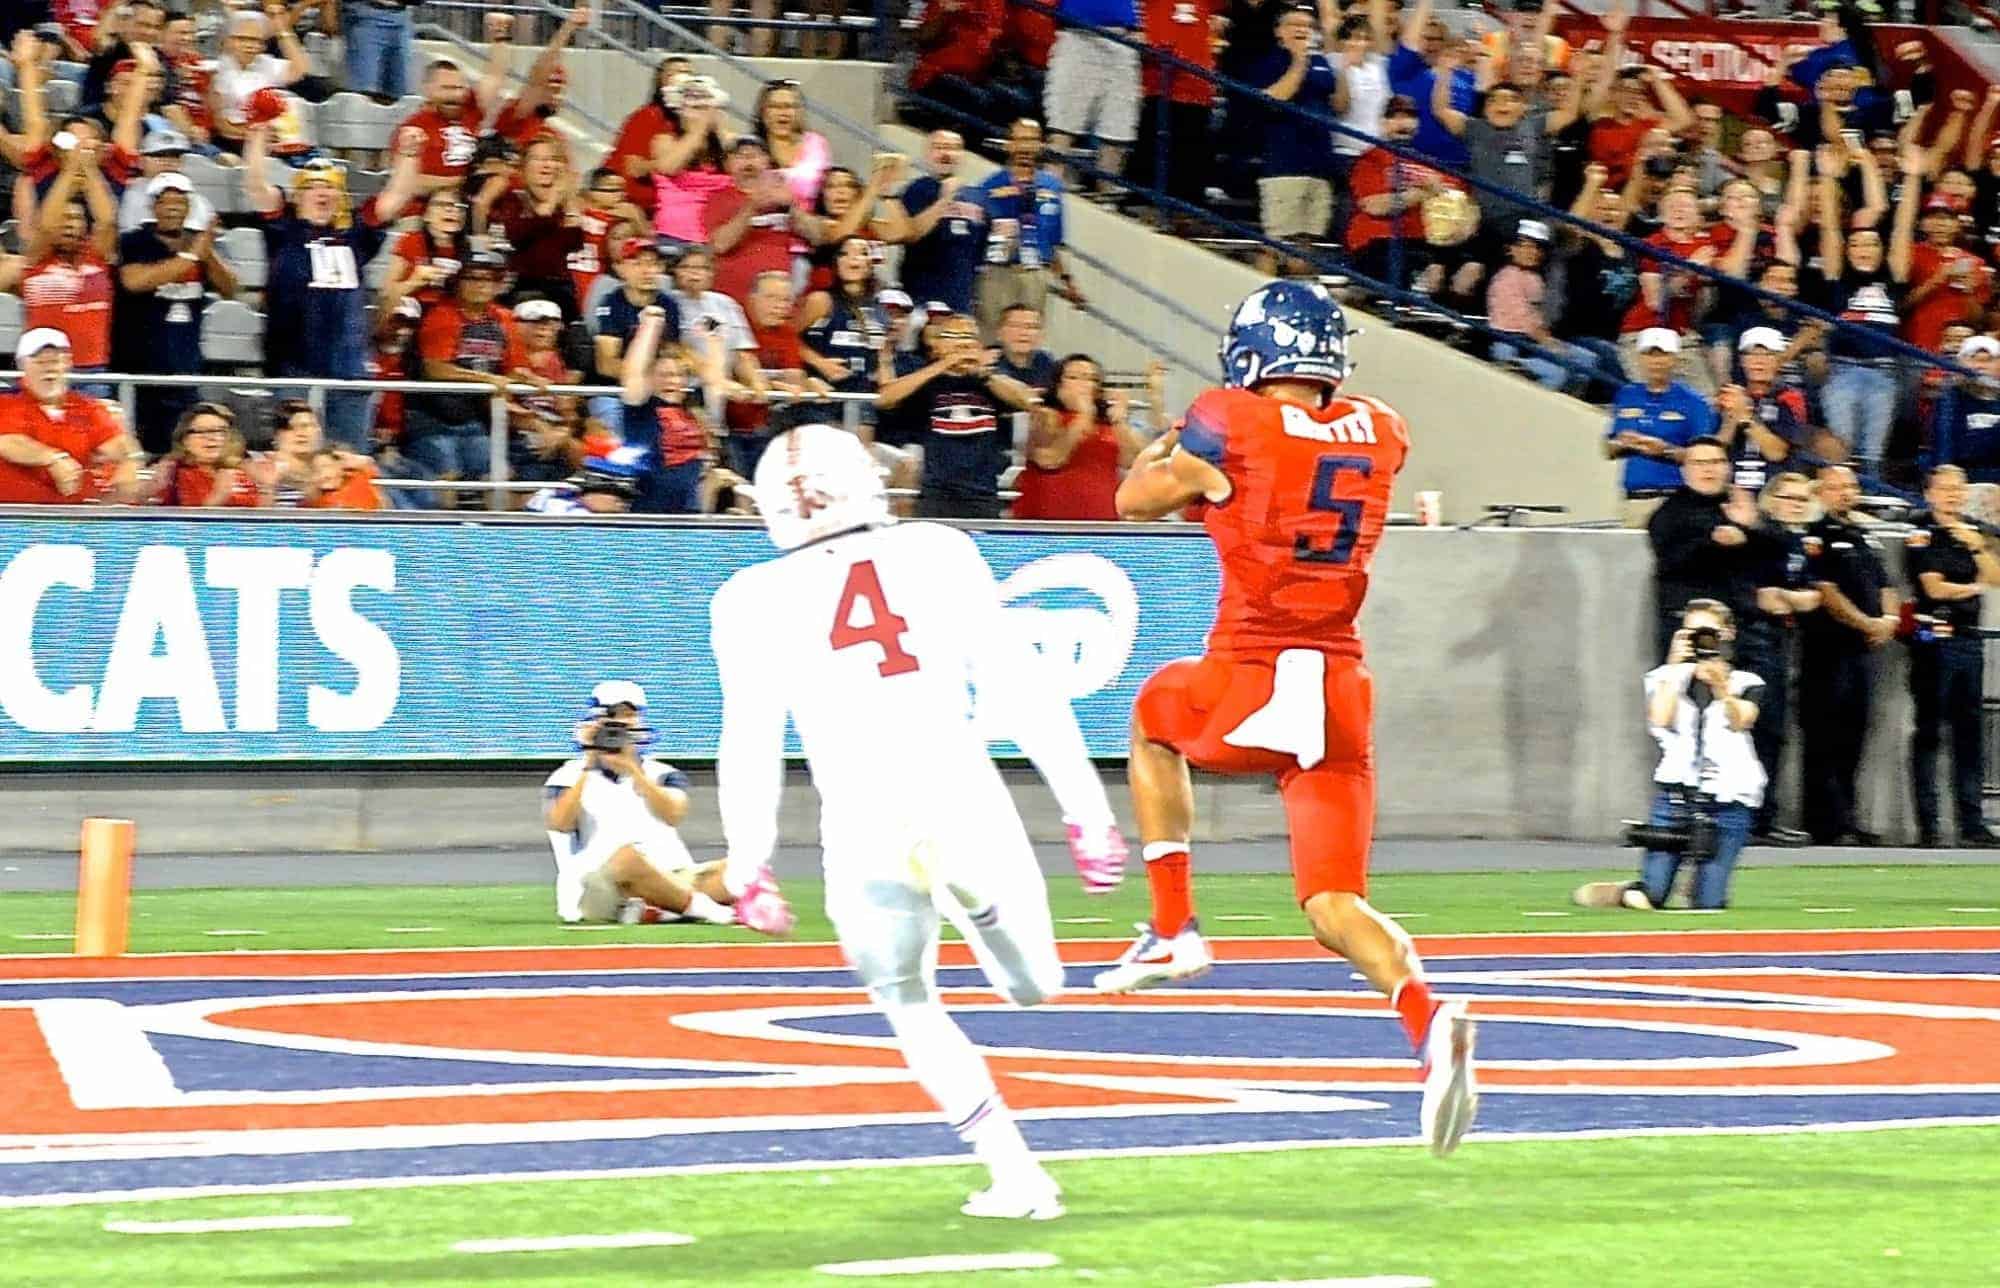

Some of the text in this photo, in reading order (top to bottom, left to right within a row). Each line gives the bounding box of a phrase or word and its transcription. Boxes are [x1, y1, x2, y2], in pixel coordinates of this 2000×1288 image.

[1294, 455, 1372, 564] 5
[0, 544, 401, 733] CATS
[830, 560, 920, 677] 4
